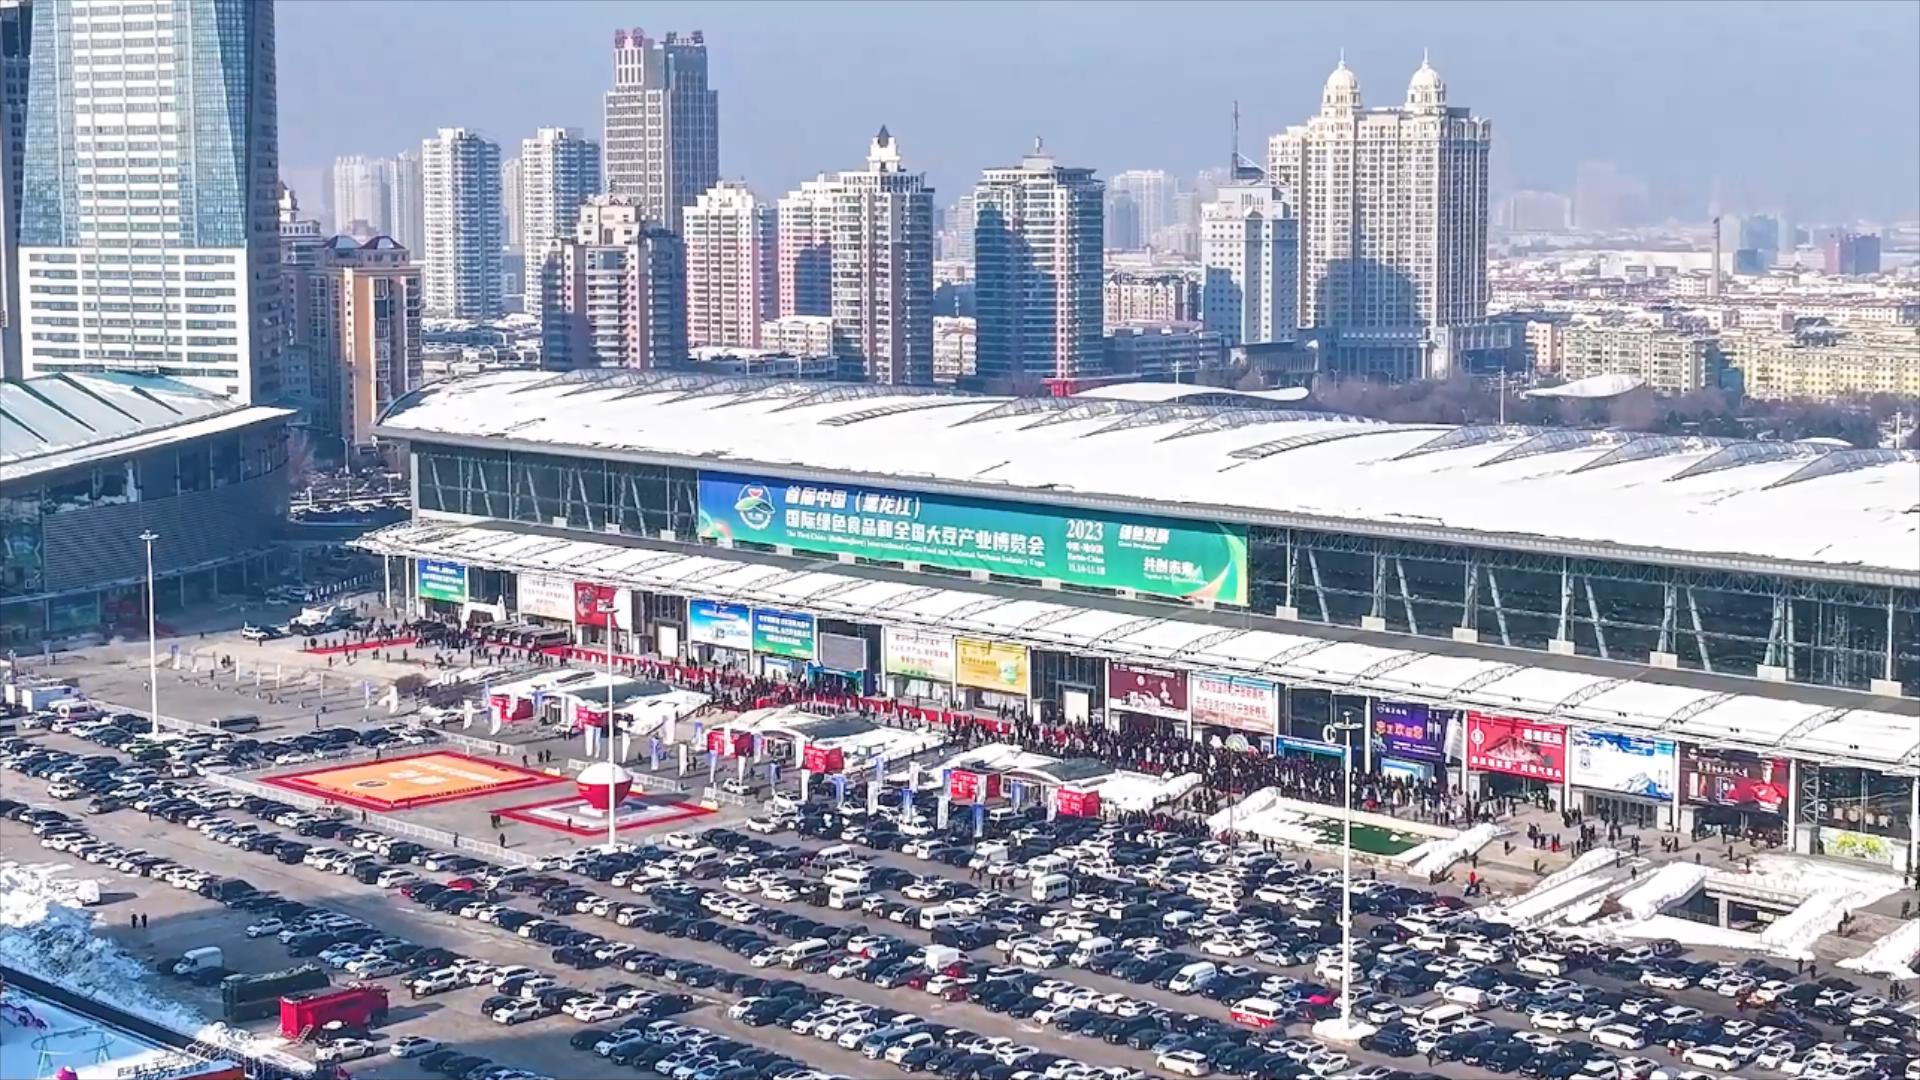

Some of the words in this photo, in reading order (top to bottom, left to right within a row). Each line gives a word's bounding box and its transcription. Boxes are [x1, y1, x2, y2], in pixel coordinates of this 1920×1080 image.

[785, 509, 1045, 556] 国际绿色食品和全国大豆产业博览会
[1066, 519, 1104, 541] 2023
[1119, 524, 1170, 544] 绿色发展
[1144, 556, 1194, 574] 共创未来
